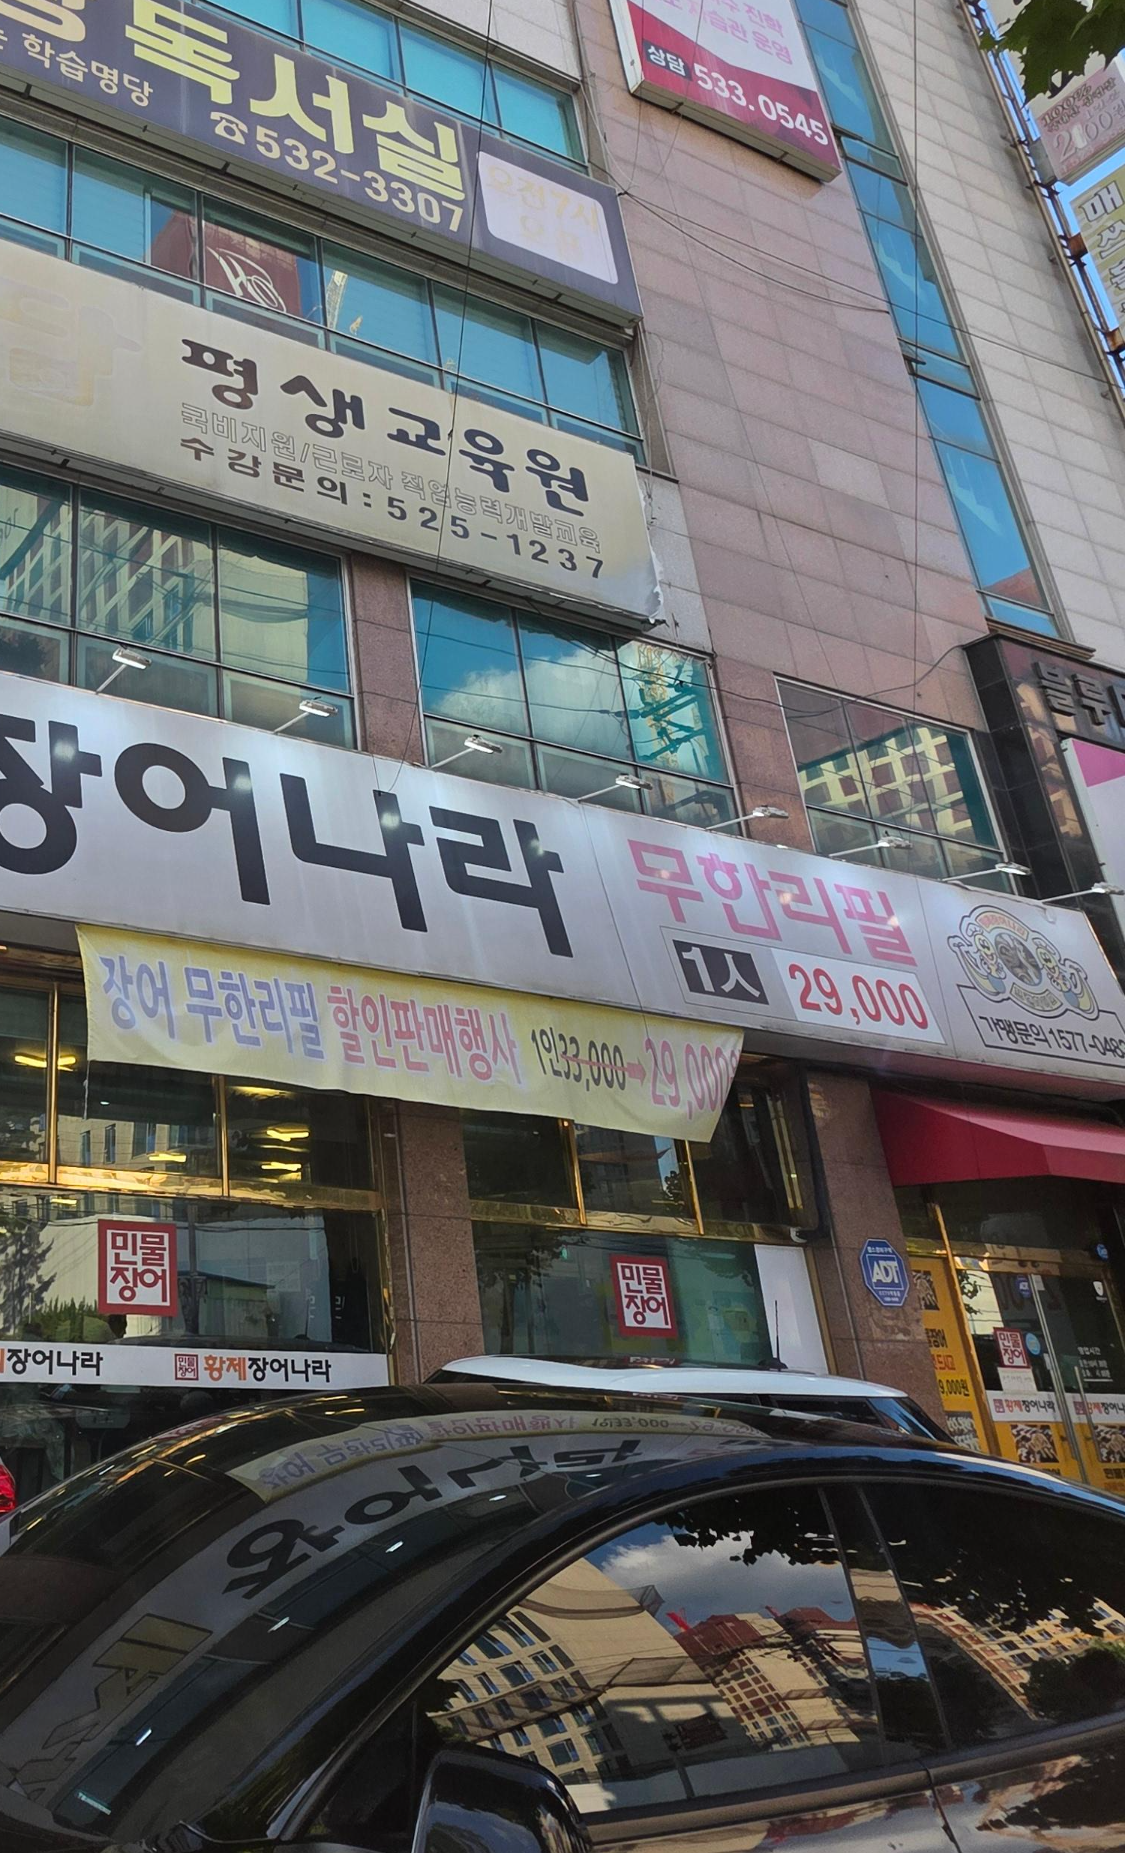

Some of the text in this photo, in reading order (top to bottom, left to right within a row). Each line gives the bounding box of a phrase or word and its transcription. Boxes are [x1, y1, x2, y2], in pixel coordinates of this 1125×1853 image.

[21, 33, 154, 107] 학습명당
[648, 45, 829, 146] 상담 533.0545
[257, 123, 465, 232] 532-3307
[181, 338, 589, 517] 평생교육원
[387, 496, 605, 580] 525-1237
[627, 839, 917, 967] 무한리필
[99, 955, 174, 1039] 장어
[184, 966, 326, 1060] 무한리필
[327, 985, 523, 1085] 할인판매행사
[789, 963, 929, 1030] 29,000
[979, 1016, 1052, 1049] 가맹문의
[110, 1231, 168, 1266] 민물
[872, 1260, 899, 1283] ADT
[109, 1265, 168, 1304] 장어
[620, 1264, 663, 1295] 민물
[624, 1294, 669, 1326] 장어
[999, 1332, 1021, 1348] 민물
[1003, 1348, 1027, 1365] 장어
